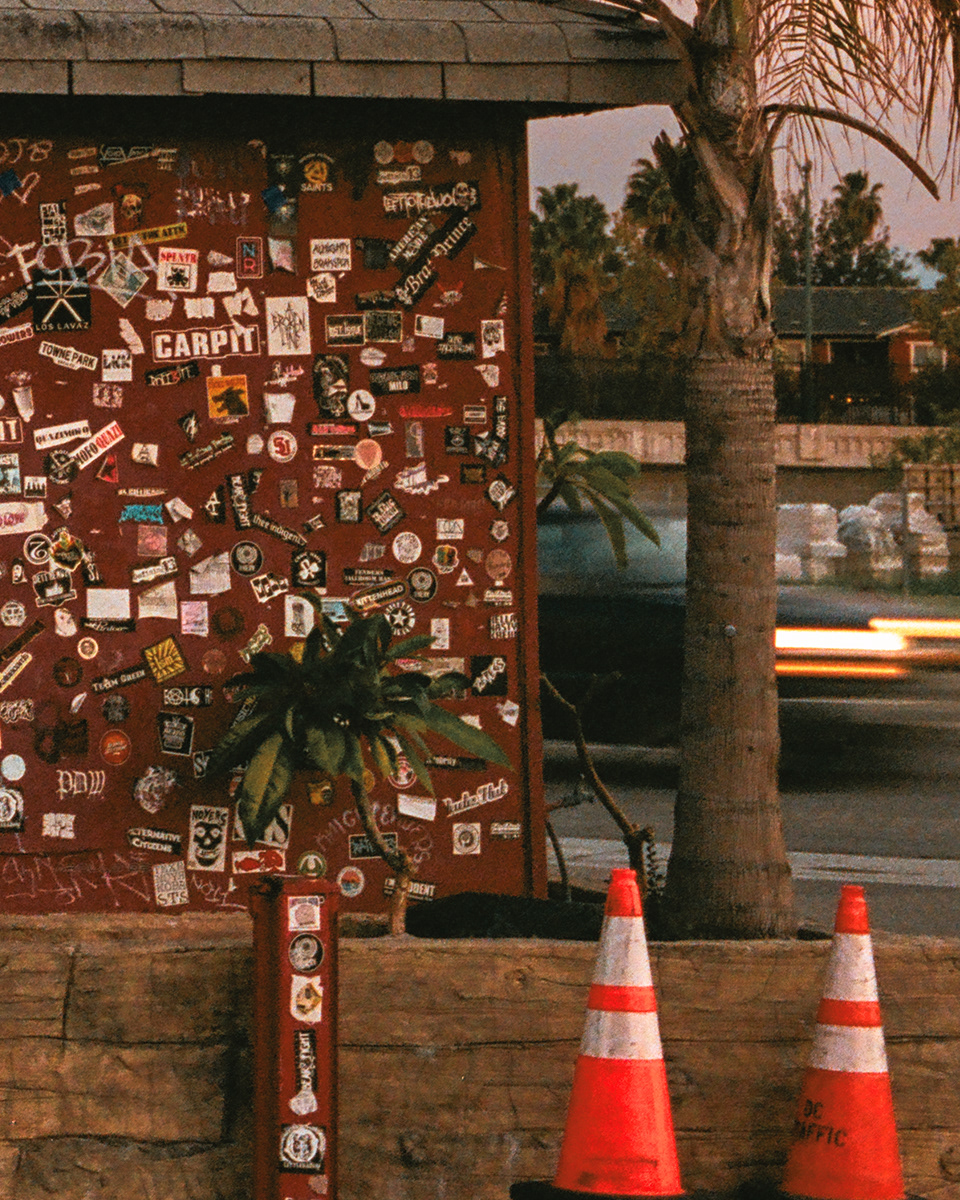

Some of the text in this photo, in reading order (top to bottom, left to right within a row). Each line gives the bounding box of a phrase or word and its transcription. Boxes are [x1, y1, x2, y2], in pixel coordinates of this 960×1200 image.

[300, 183, 333, 192] SAINTS
[35, 322, 54, 331] LOS
[154, 327, 256, 359] CARPIT
[42, 343, 73, 362] TOWNE
[71, 350, 95, 368] PARK
[355, 584, 404, 606] KITTENHEAD
[119, 669, 146, 683] GREEN
